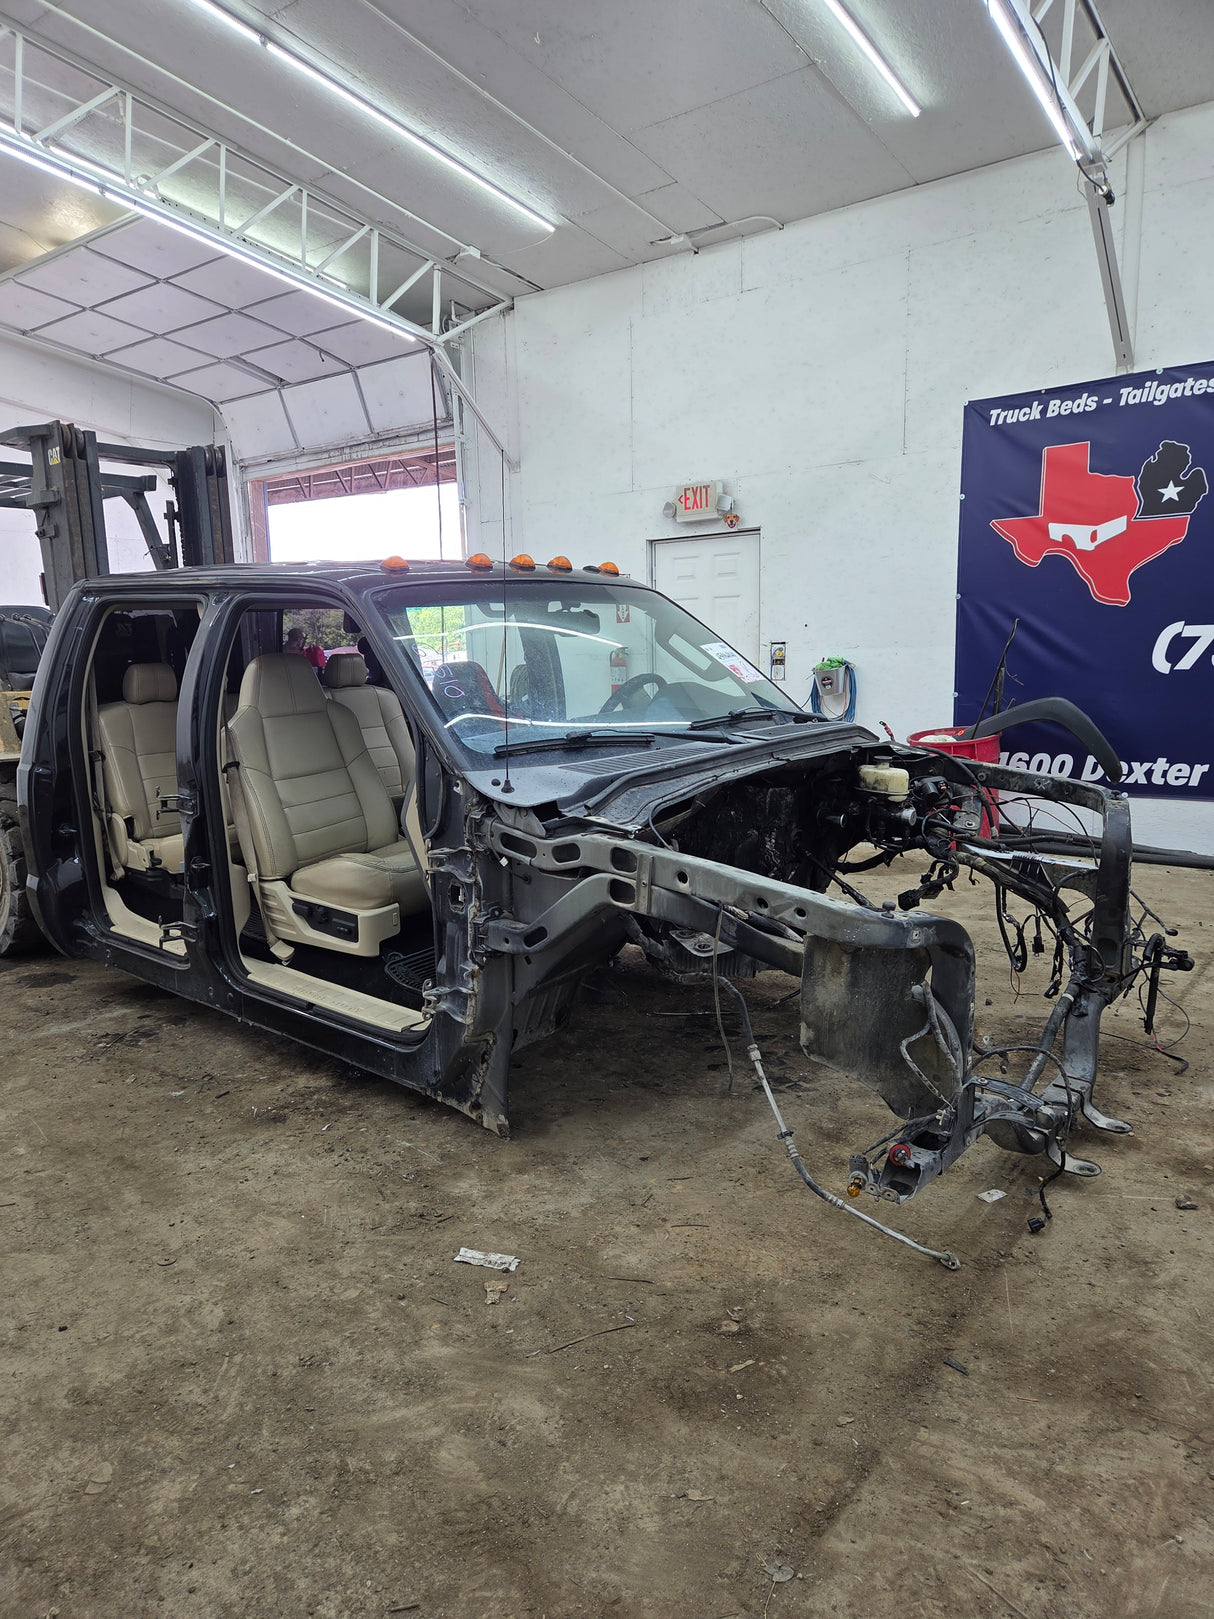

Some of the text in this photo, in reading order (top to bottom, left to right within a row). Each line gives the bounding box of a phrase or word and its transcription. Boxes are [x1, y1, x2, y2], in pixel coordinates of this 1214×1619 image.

[990, 401, 1044, 426] Truck
[1046, 393, 1098, 418] Beds
[1119, 378, 1214, 406] Tailgates
[48, 446, 61, 466] CAT
[683, 484, 710, 511] EXIT
[1151, 620, 1214, 675] (7
